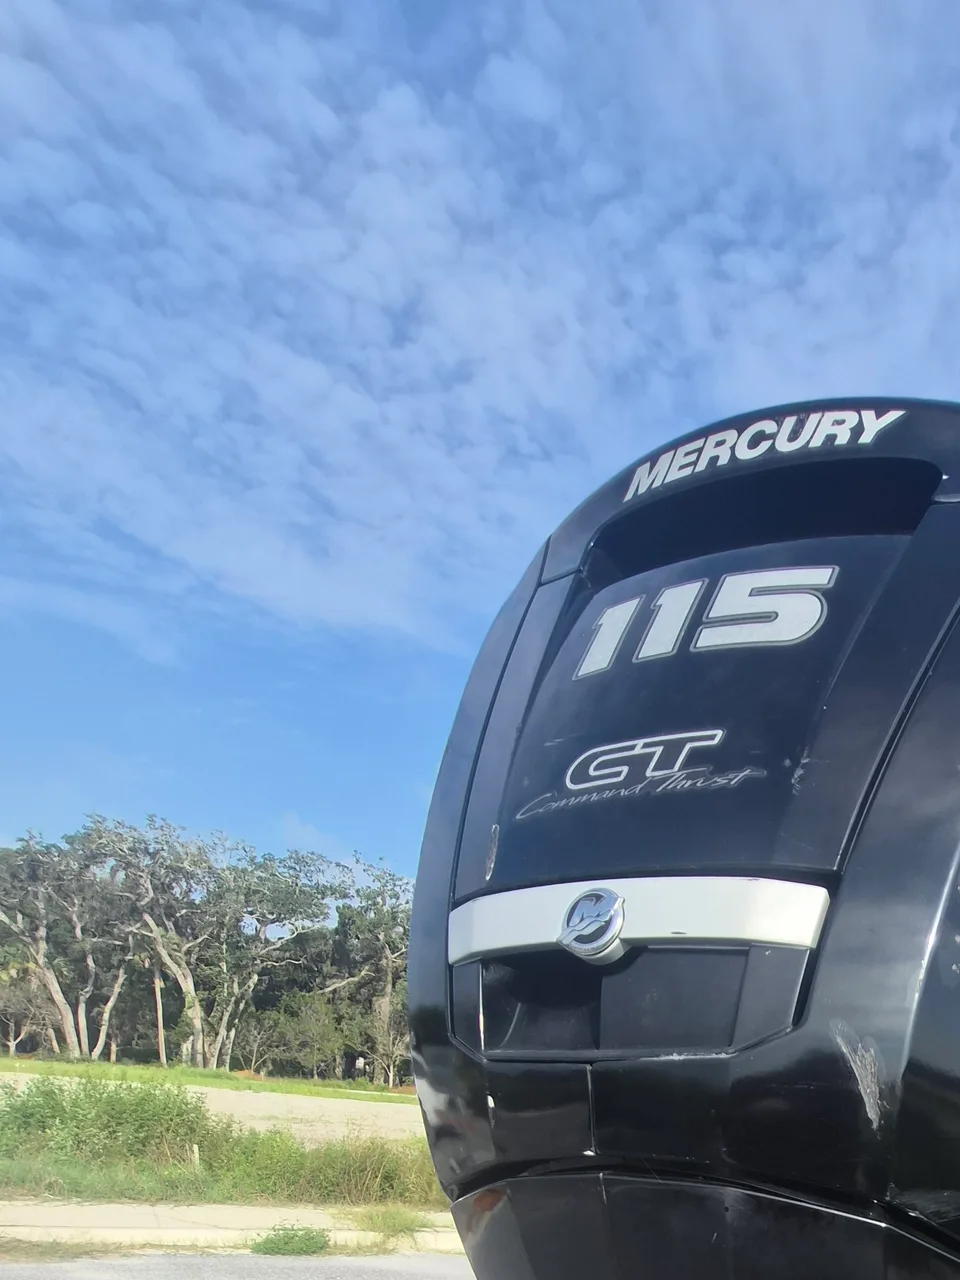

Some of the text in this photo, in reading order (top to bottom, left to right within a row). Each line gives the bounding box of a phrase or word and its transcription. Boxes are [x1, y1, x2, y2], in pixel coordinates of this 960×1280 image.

[623, 410, 906, 502] MERCURY
[573, 566, 838, 679] 115
[516, 768, 767, 819] Command Thrust
[566, 729, 724, 790] GT
